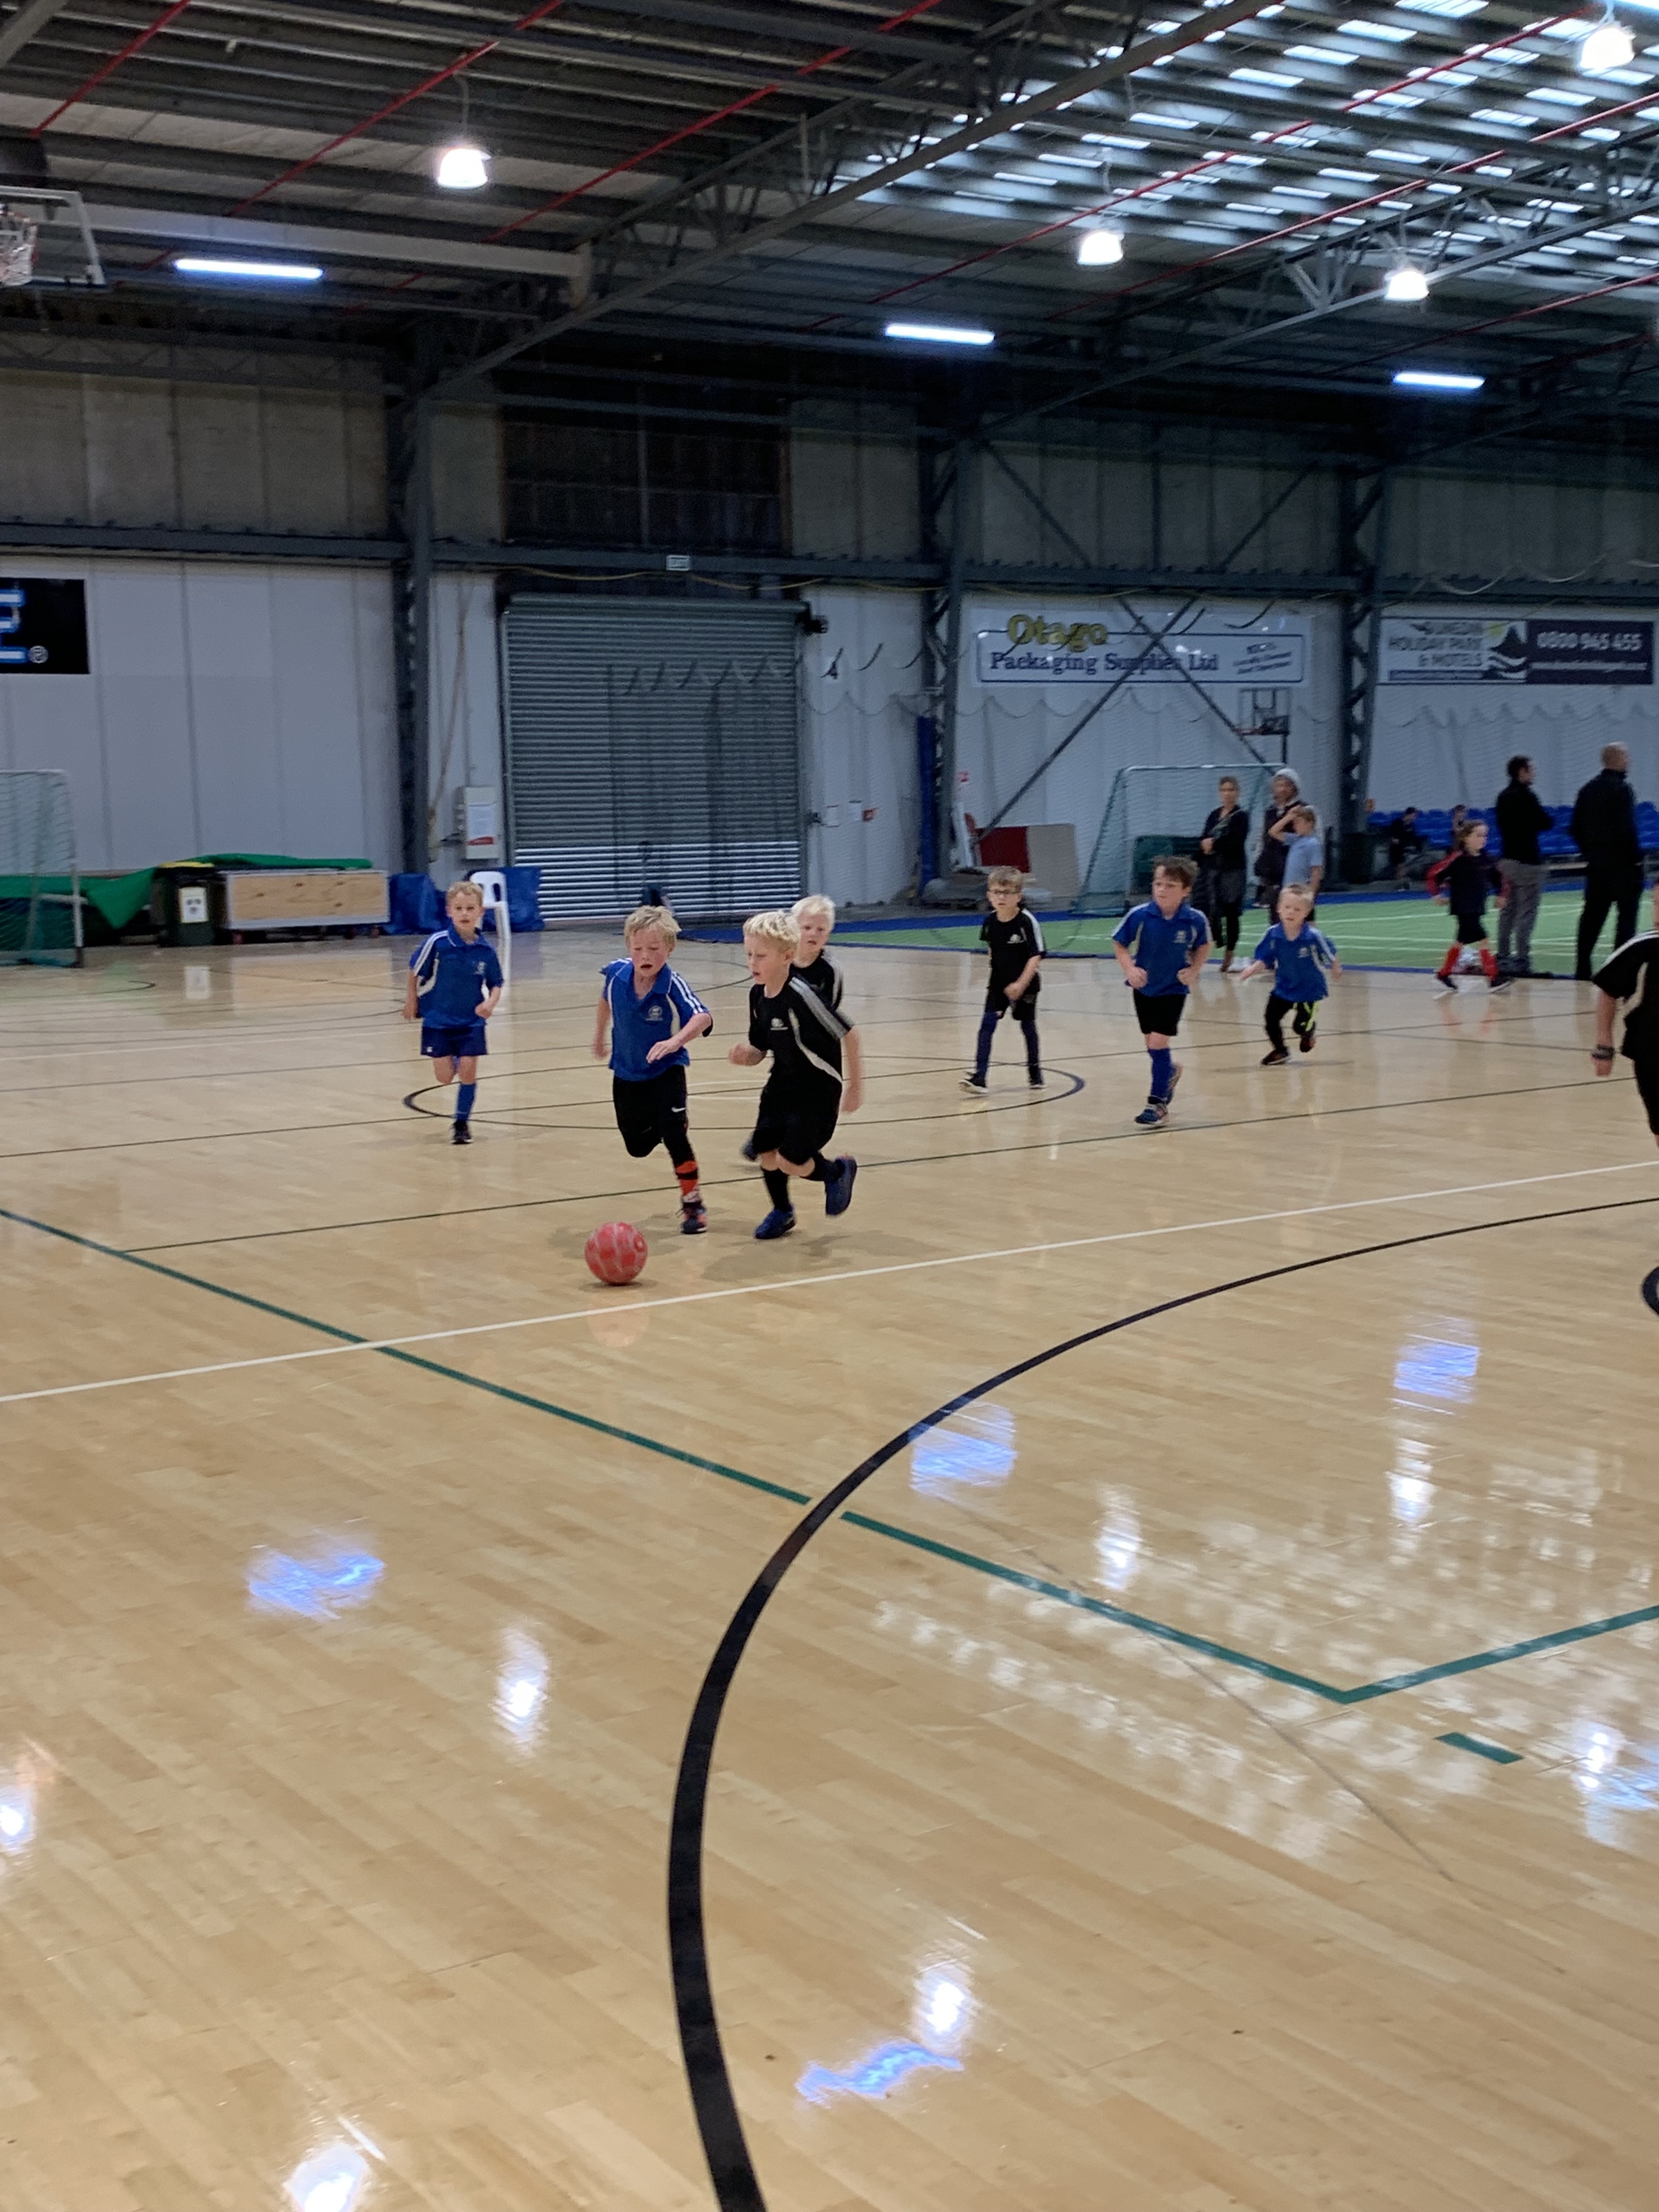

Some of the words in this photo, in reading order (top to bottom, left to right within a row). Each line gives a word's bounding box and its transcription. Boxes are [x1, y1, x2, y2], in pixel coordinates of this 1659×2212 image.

[1006, 613, 1108, 653] Otago
[990, 651, 1098, 675] Packaging
[1188, 653, 1218, 670] Ltd
